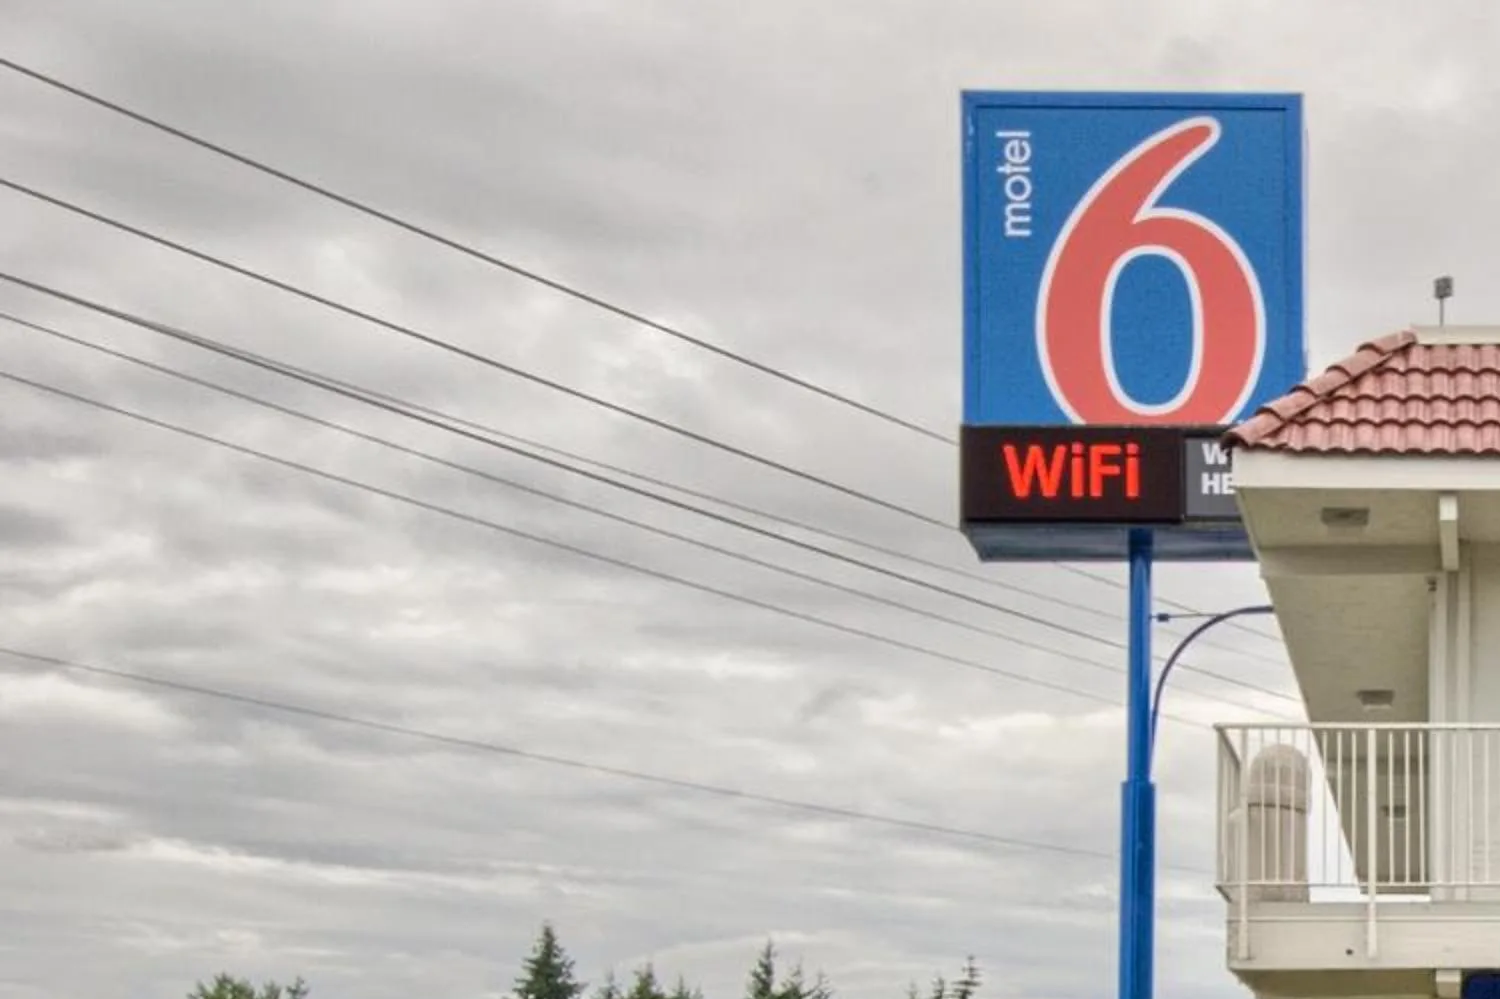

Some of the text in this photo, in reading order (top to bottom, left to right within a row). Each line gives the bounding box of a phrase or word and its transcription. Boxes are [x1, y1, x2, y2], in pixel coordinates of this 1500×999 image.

[996, 130, 1032, 237] motel
[1036, 116, 1266, 425] 6
[1003, 442, 1140, 498] WiFi
